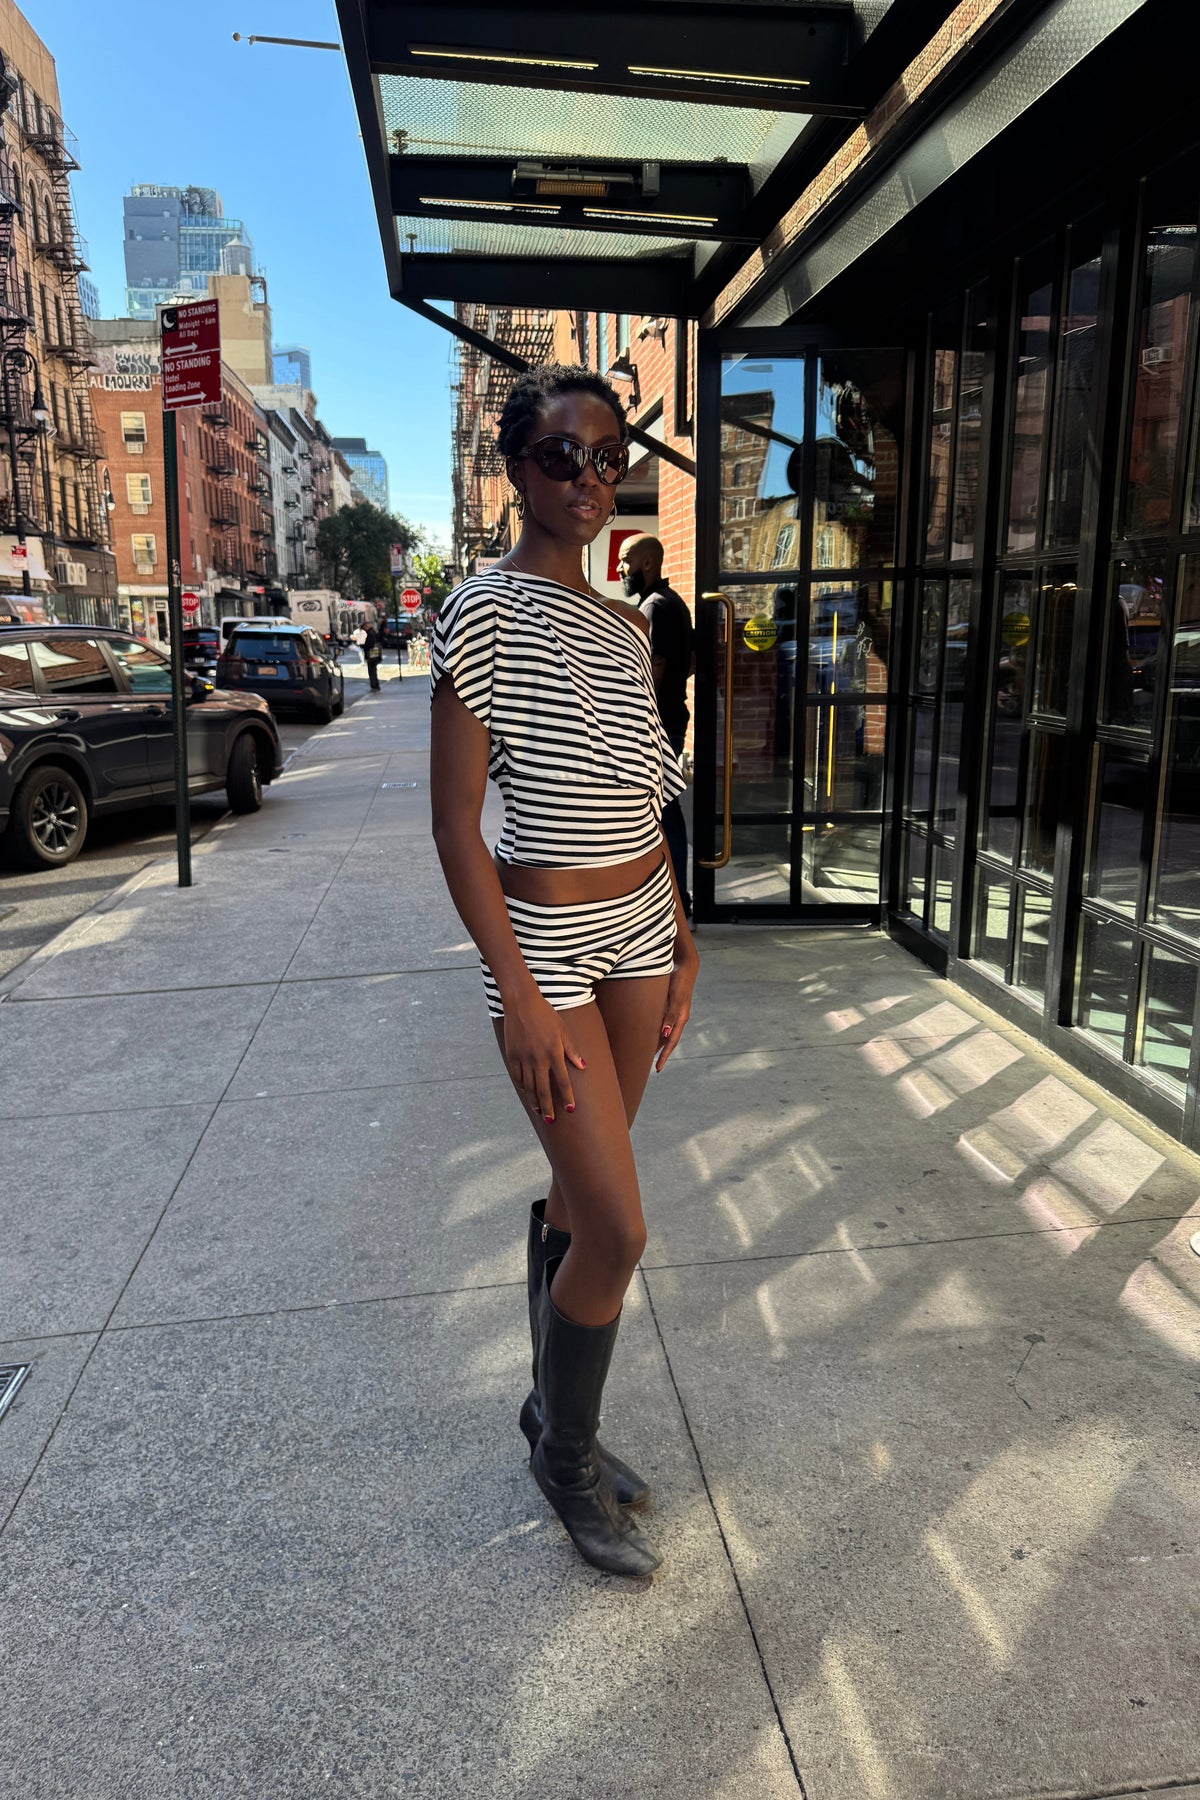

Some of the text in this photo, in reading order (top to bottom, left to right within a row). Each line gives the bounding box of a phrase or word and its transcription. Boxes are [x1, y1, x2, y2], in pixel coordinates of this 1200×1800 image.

[178, 304, 217, 318] NO STANDING
[179, 320, 200, 330] Midnight
[165, 362, 175, 372] NO
[176, 356, 211, 371] STANDING
[165, 374, 180, 383] Hotel
[165, 381, 201, 393] Loading Zone
[181, 598, 199, 606] STOP
[402, 595, 420, 604] STOP
